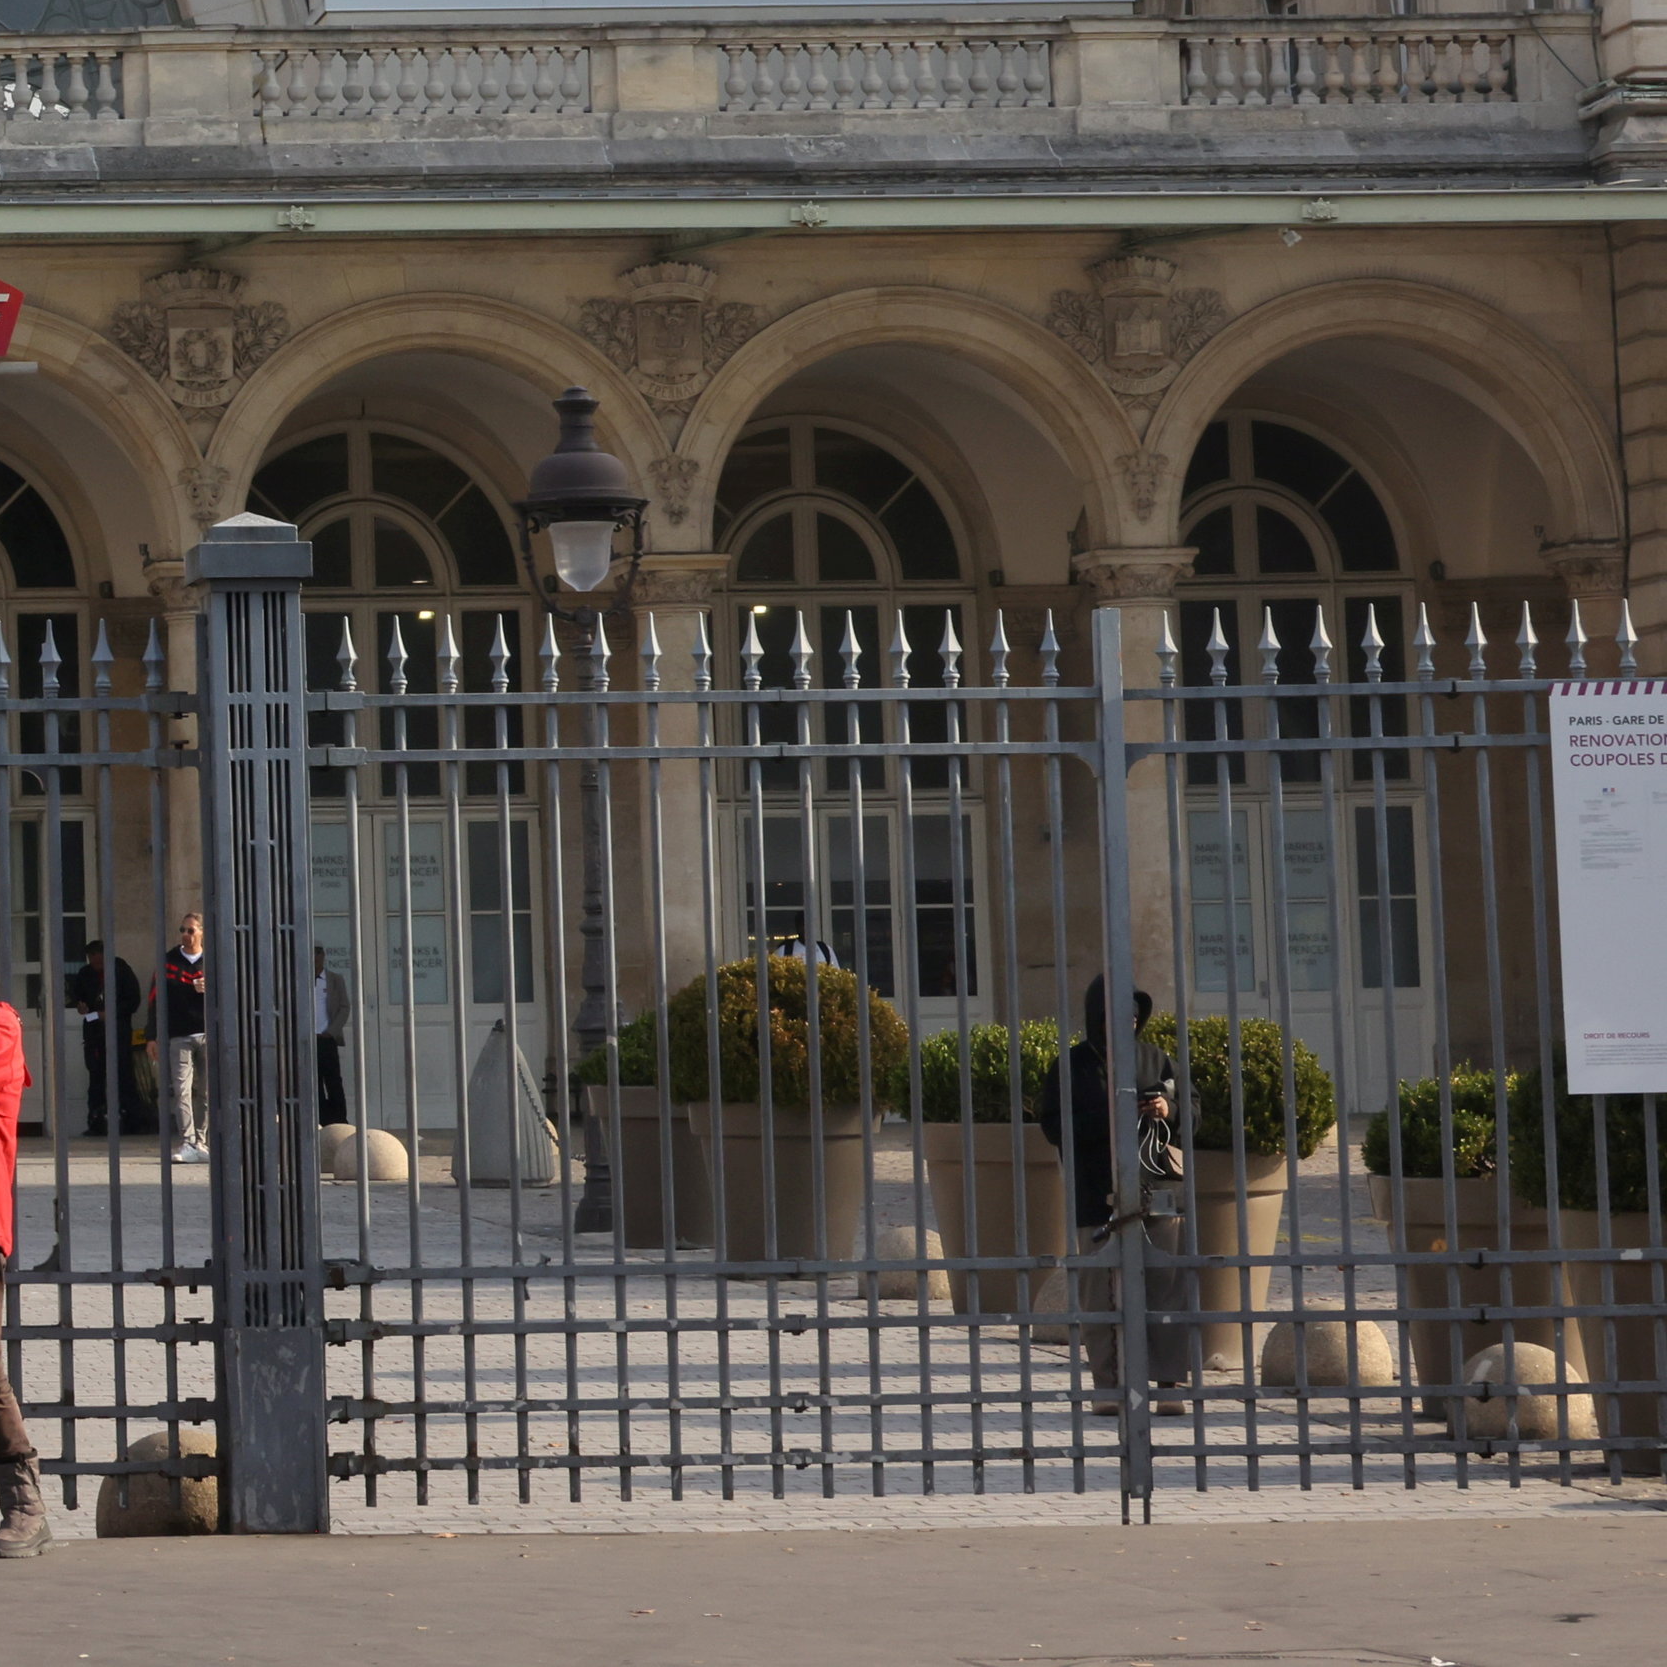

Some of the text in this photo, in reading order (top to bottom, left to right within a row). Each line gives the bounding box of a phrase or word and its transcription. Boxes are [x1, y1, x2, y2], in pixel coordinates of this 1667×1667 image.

[1569, 716, 1602, 725] PARIS
[1612, 716, 1644, 725] GARE
[1649, 715, 1664, 724] DE
[1570, 753, 1655, 766] COUPOLES
[1195, 855, 1244, 864] SPENER
[312, 868, 348, 877] PENCE
[1199, 946, 1249, 955] SPENER
